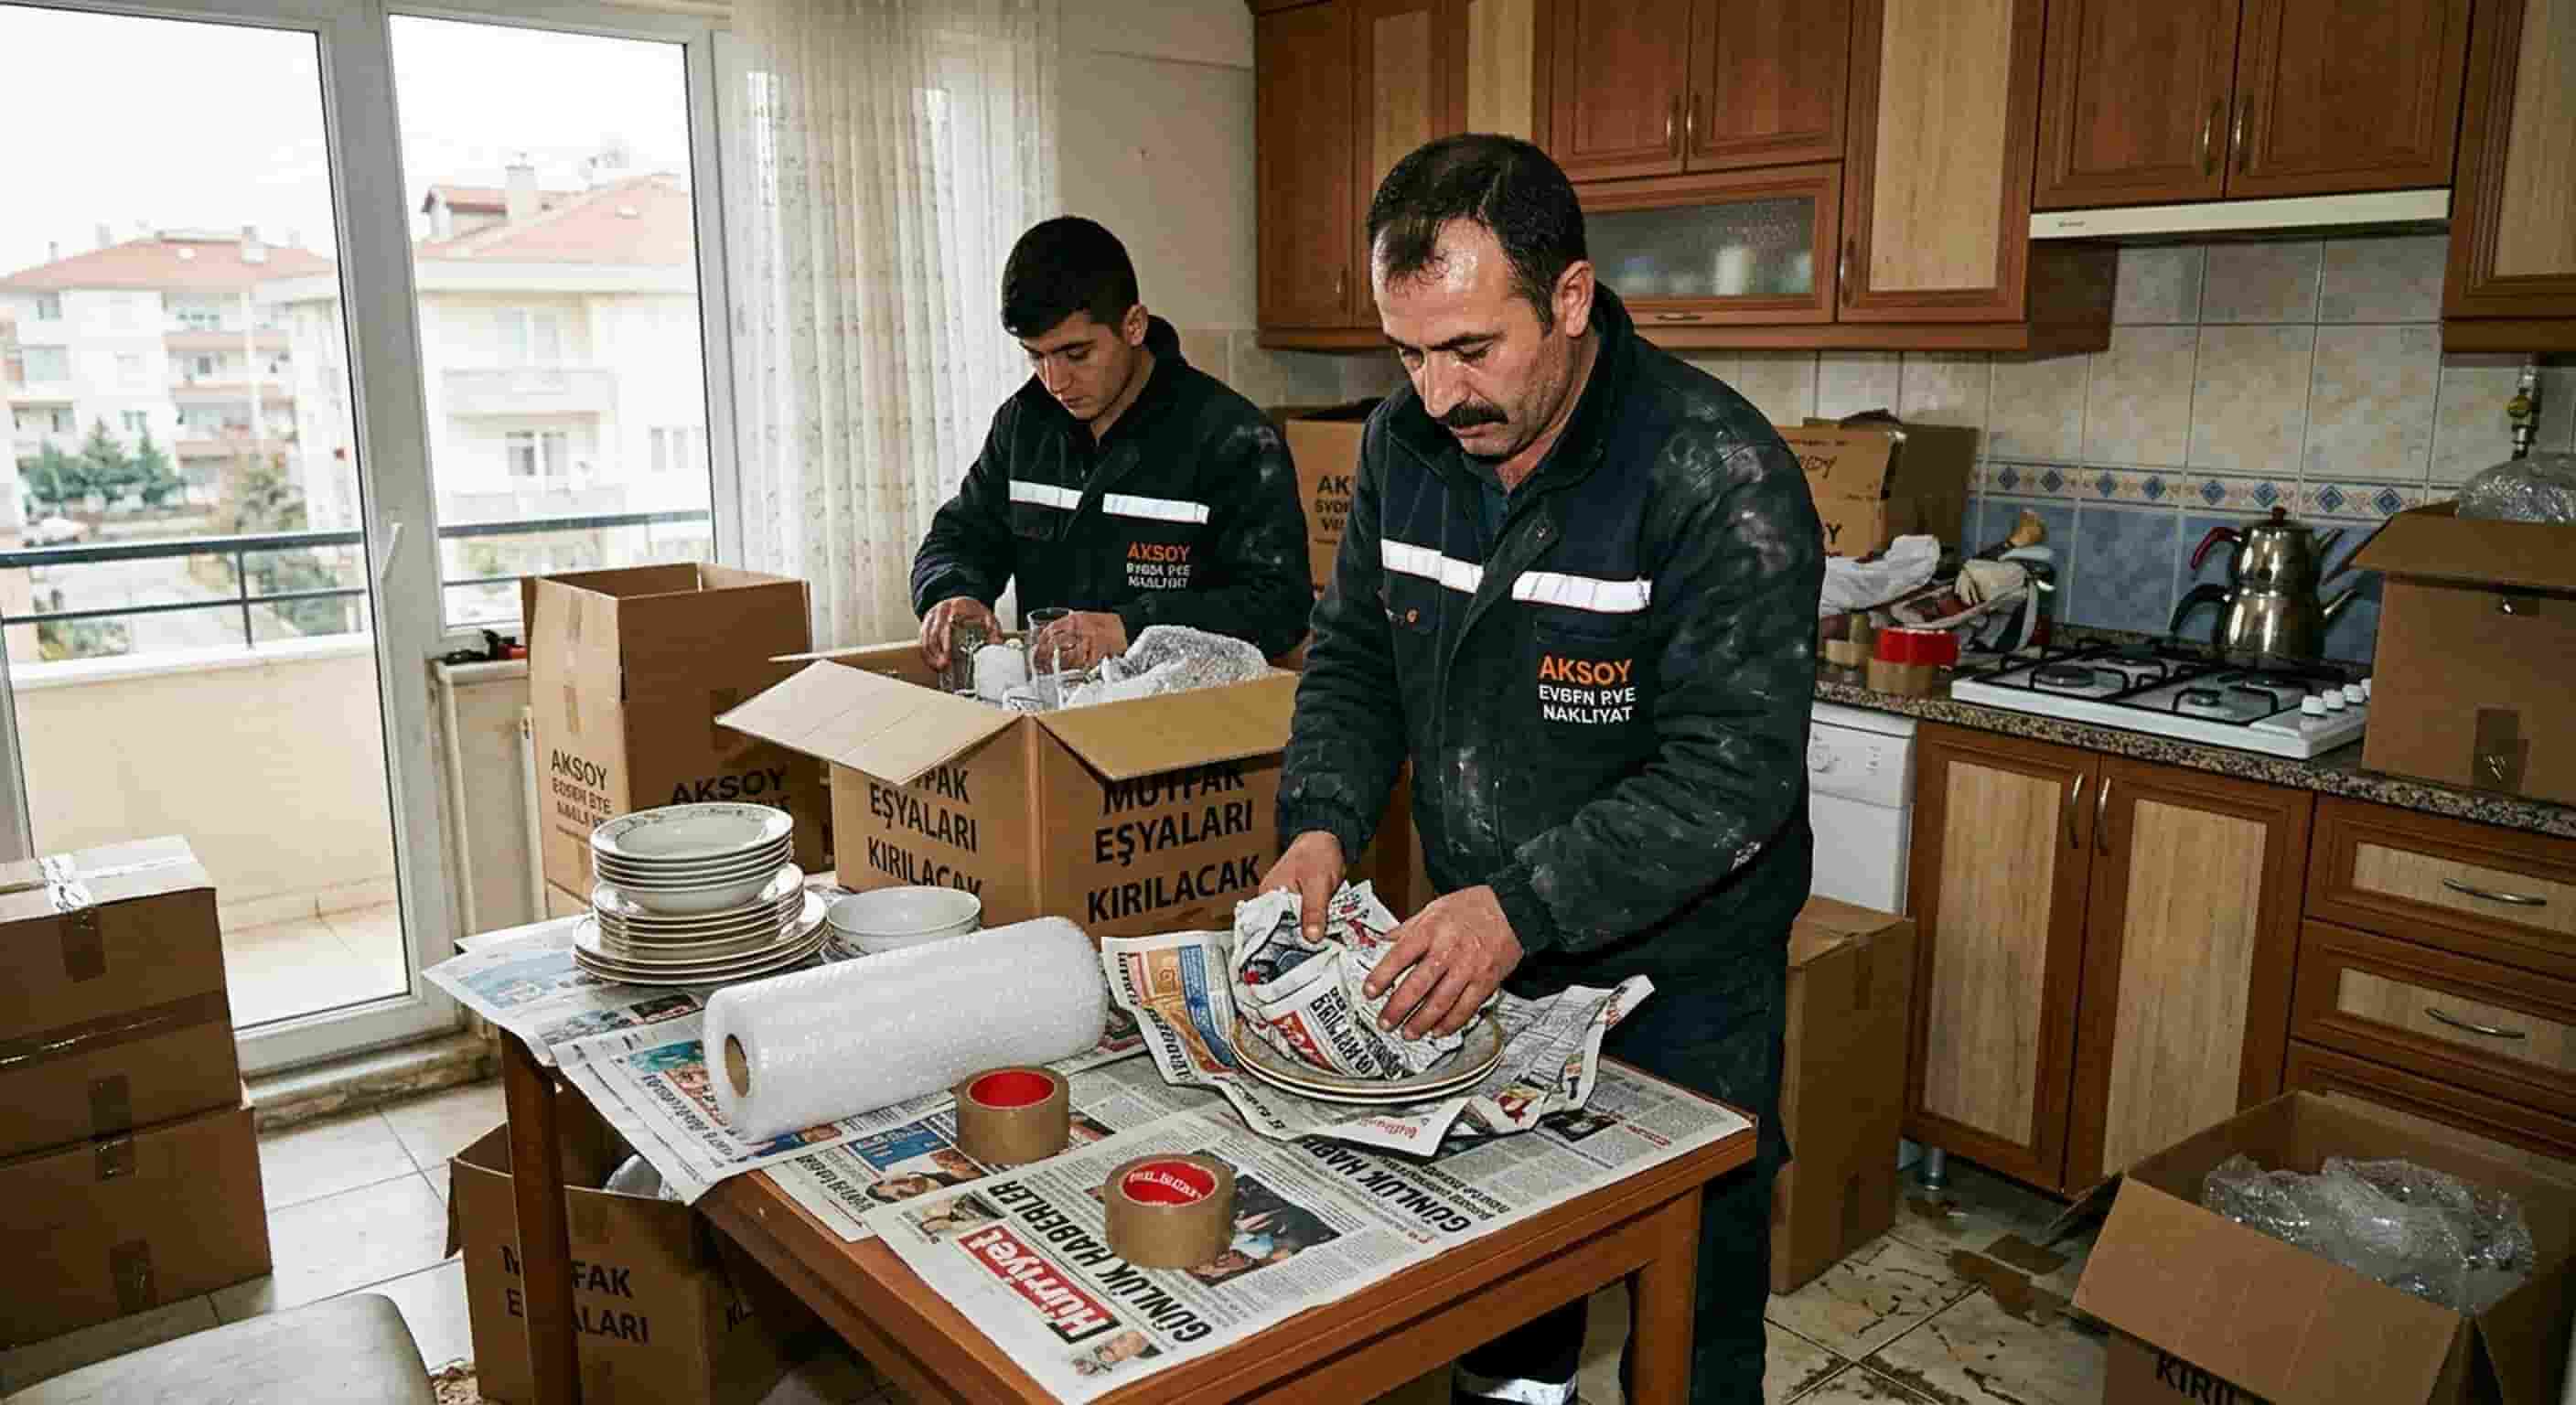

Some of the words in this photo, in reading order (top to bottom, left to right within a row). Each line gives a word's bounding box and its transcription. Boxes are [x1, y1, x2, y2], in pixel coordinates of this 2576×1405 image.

[1127, 542, 1191, 563] AKSOY
[1538, 655, 1632, 686] AKSOY
[551, 747, 607, 791] AKSOY
[671, 766, 788, 804] AKSOY
[869, 782, 977, 853] EŞYALARI
[1095, 799, 1253, 866] EŞYALARI
[1088, 854, 1261, 924] KIRILACAK
[988, 1180, 1115, 1267] HABERLER
[1095, 1261, 1213, 1343] GÜNLÜK
